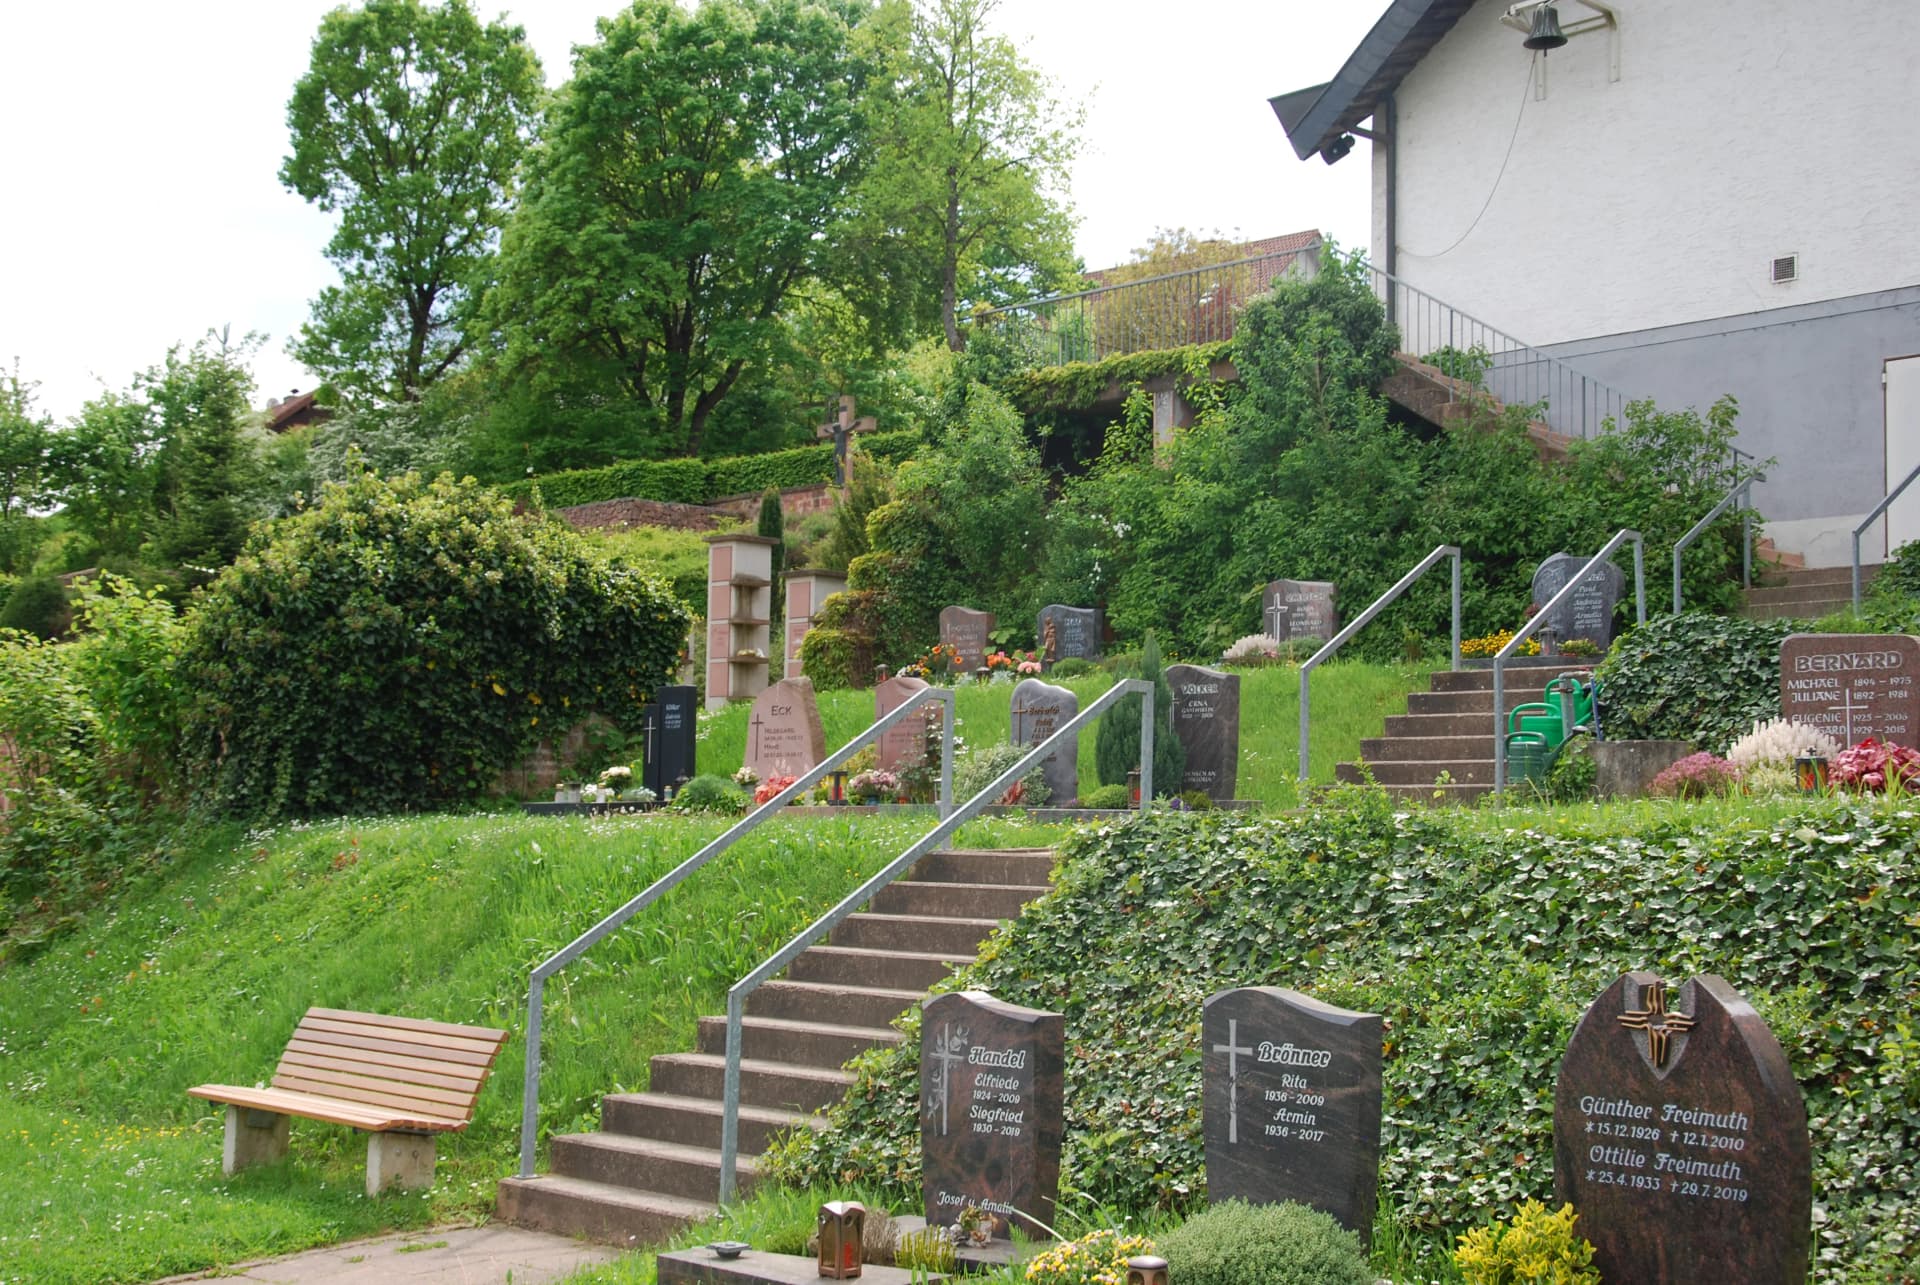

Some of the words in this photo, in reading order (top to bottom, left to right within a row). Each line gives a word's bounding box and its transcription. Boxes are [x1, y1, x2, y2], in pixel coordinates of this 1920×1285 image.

[1795, 651, 1903, 672] BERNARD
[1787, 678, 1840, 690] MICHAEL
[1889, 676, 1912, 685] 1975
[1791, 690, 1841, 703] JULIANE
[1853, 691, 1874, 700] 1892
[1888, 690, 1908, 699] 1981
[771, 705, 792, 716] ECK
[1791, 712, 1842, 723] EUGENIE
[1853, 713, 1873, 722] 1925
[1853, 726, 1873, 735] 1929
[1884, 725, 1906, 734] 2015
[968, 1046, 1026, 1069] Handel
[1257, 1040, 1332, 1068] Brönner
[974, 1072, 1020, 1090] Elfriede
[1281, 1073, 1307, 1089] Rita
[973, 1089, 992, 1101] 1924
[998, 1092, 1021, 1104] 2009
[1264, 1089, 1288, 1103] 1936
[1295, 1093, 1325, 1107] 2009
[969, 1104, 1024, 1124] Siegfried
[1272, 1107, 1316, 1126] Armin
[1579, 1095, 1653, 1120] Günther
[1660, 1103, 1749, 1131] Freimuth
[973, 1122, 993, 1134] 1930
[1000, 1125, 1021, 1137] 2019
[1264, 1124, 1288, 1138] 1936
[1298, 1128, 1324, 1142] 2017
[1589, 1144, 1646, 1168] Ottilie
[1654, 1152, 1742, 1181] Freimuth
[936, 1191, 967, 1207] Josef
